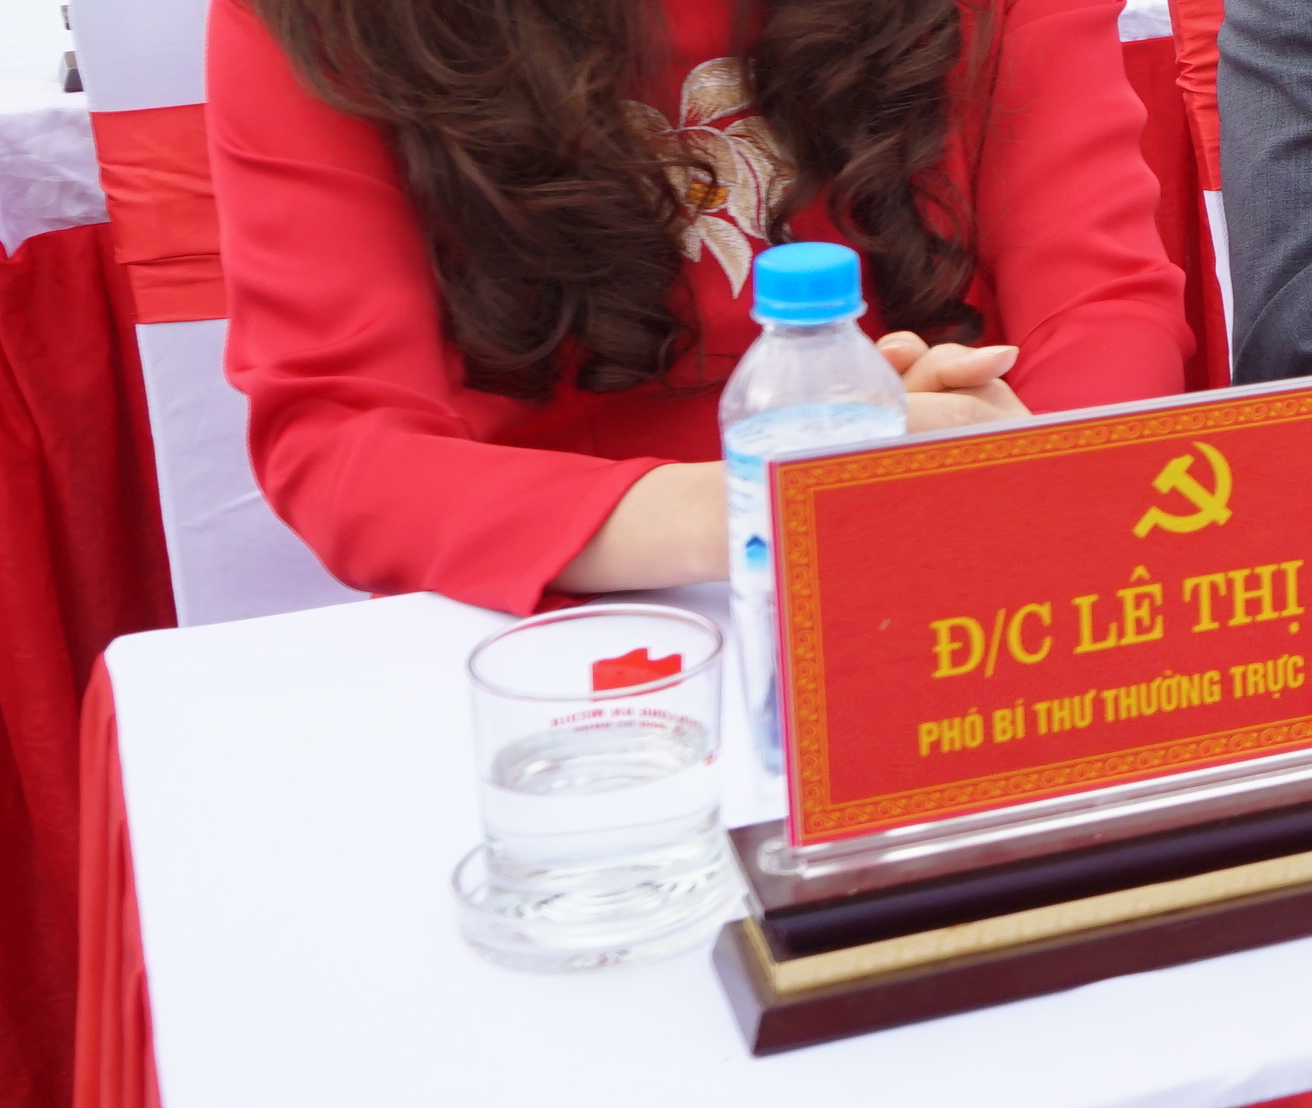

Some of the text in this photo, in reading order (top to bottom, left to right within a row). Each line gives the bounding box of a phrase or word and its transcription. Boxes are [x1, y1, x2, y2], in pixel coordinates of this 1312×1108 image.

[929, 602, 1053, 678] Đ/C
[1072, 565, 1164, 654] LÊ
[1182, 559, 1303, 634] THỊ
[917, 707, 984, 756] PHÓ
[992, 699, 1025, 743] BÍ
[1033, 687, 1095, 735] THƯ
[1102, 669, 1222, 722] THƯỜNG
[1230, 652, 1305, 699] TRỰC
